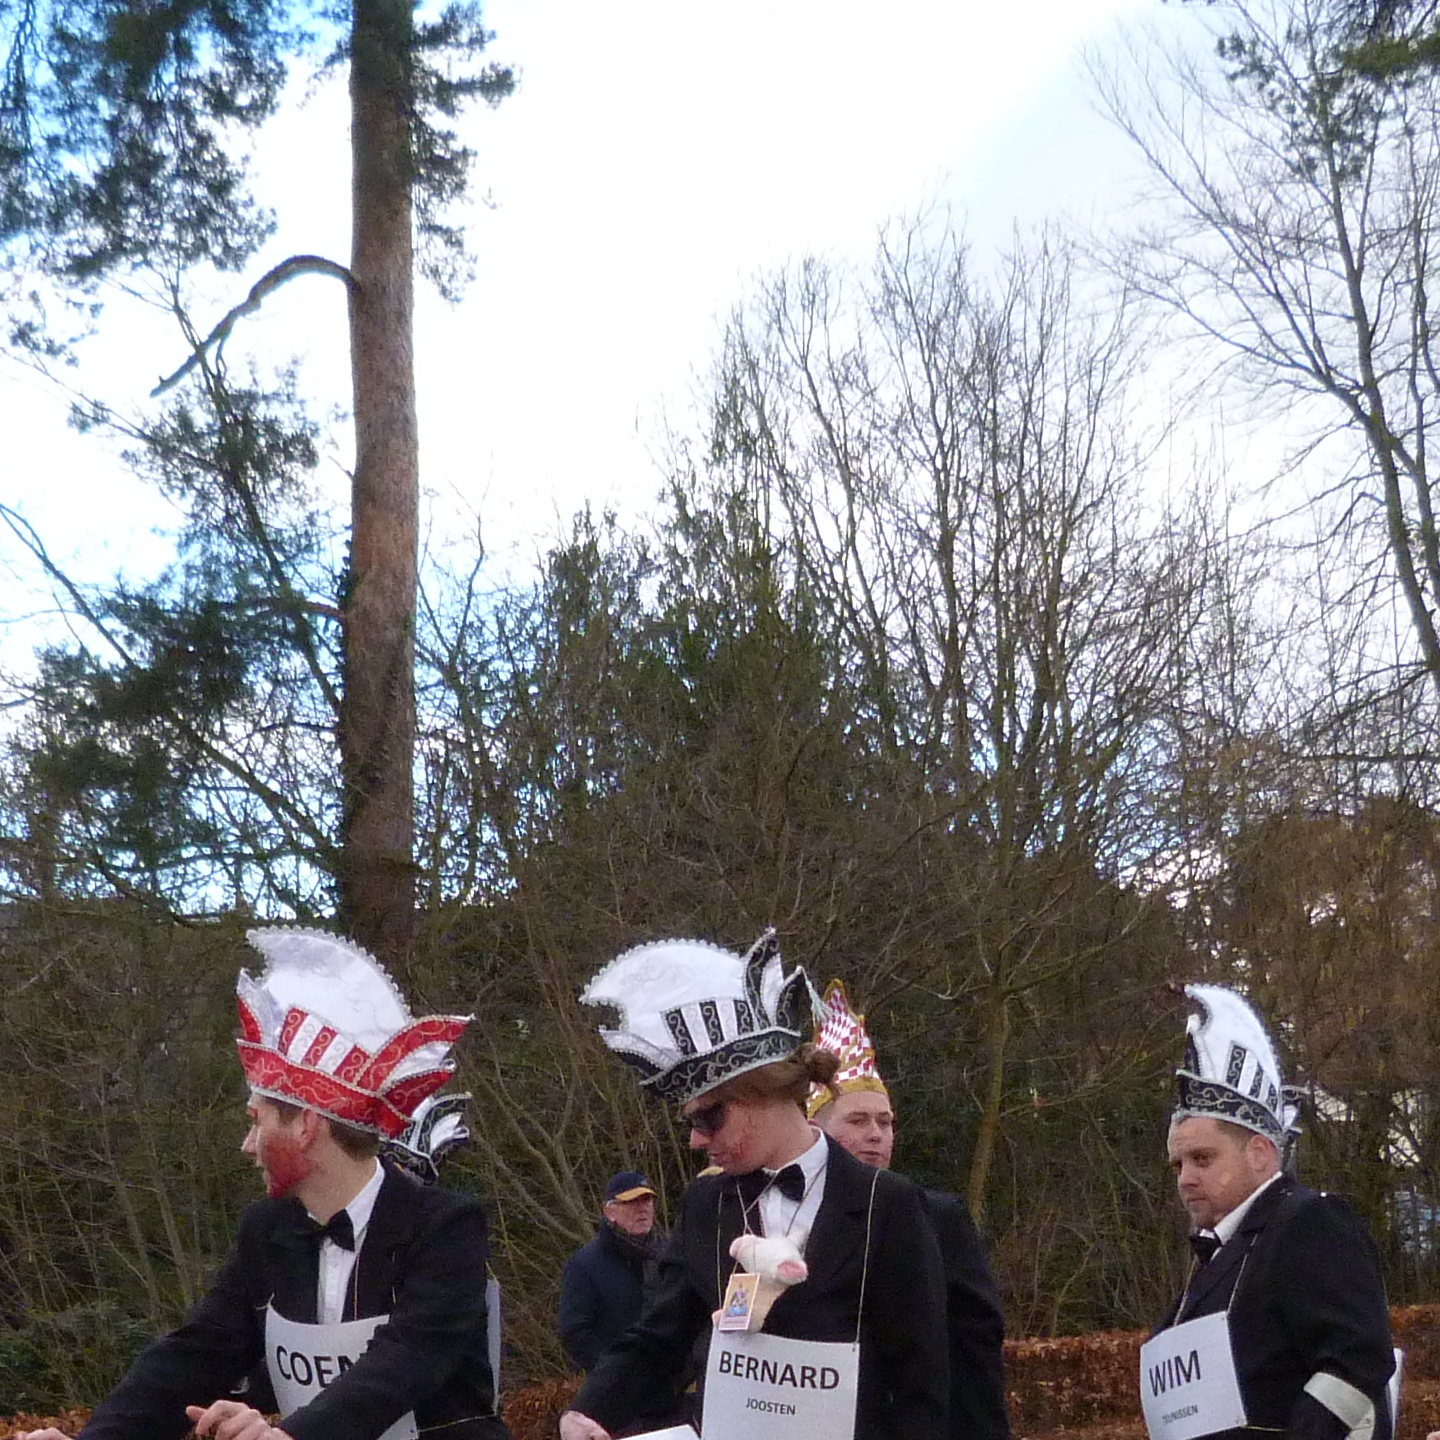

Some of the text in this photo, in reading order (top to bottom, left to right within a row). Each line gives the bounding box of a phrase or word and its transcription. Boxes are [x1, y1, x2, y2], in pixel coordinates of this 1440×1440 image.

[719, 1350, 840, 1390] BERNARD
[1149, 1349, 1201, 1398] WIM
[746, 1398, 796, 1415] JOOSTEN
